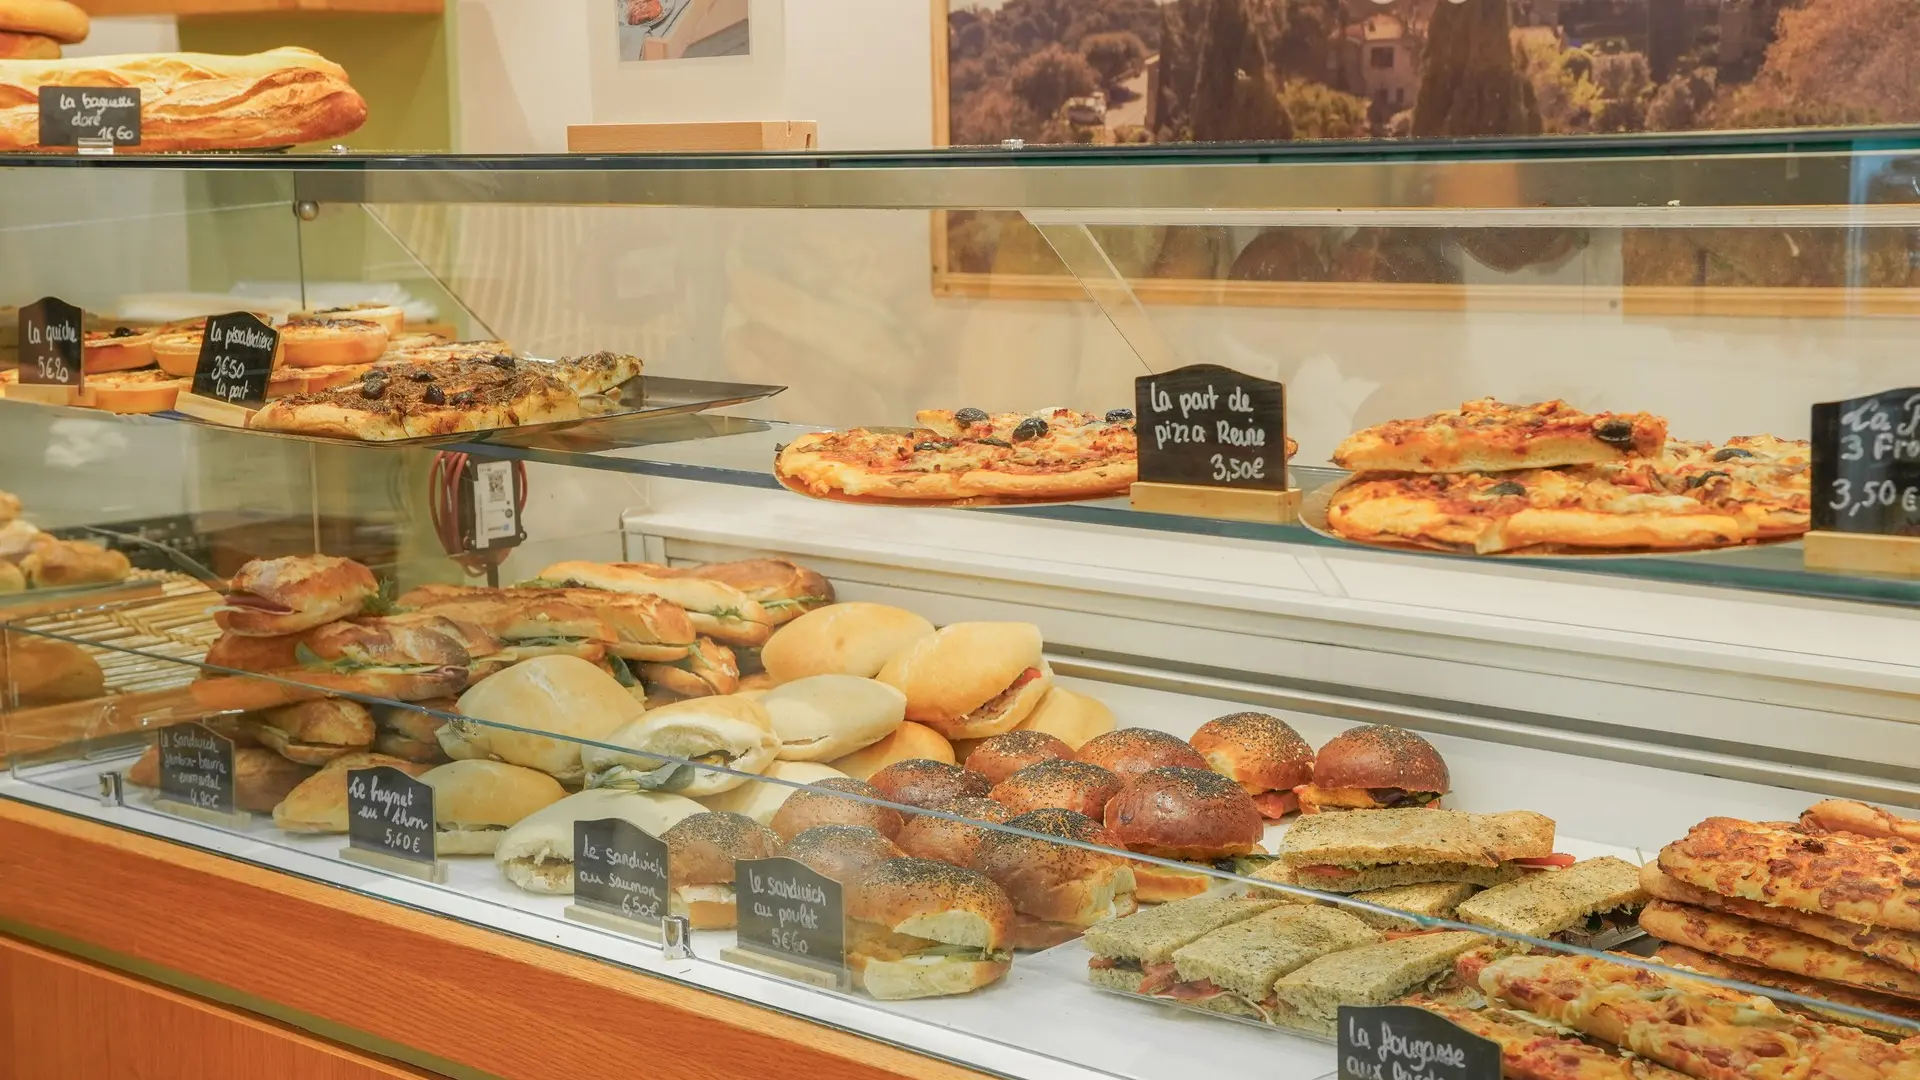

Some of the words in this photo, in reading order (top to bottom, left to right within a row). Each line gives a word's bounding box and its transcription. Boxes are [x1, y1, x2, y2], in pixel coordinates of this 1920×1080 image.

[28, 319, 41, 345] La
[45, 319, 78, 352] quiche
[210, 320, 222, 342] La
[211, 355, 245, 380] 3€50
[228, 380, 249, 403] part
[1179, 384, 1219, 419] part
[1228, 386, 1254, 412] de
[1841, 399, 1892, 432] La
[1154, 420, 1206, 450] pizza
[1216, 417, 1266, 447] Reine
[1841, 434, 1864, 460] 3
[1210, 453, 1266, 482] 3,50€
[370, 775, 413, 817] bagnat
[358, 804, 378, 820] au
[391, 807, 428, 831] thon
[580, 870, 604, 885] au
[621, 893, 661, 921] 6,50€
[754, 901, 773, 918] au
[778, 903, 818, 930] poulet
[771, 927, 808, 954] 5€60
